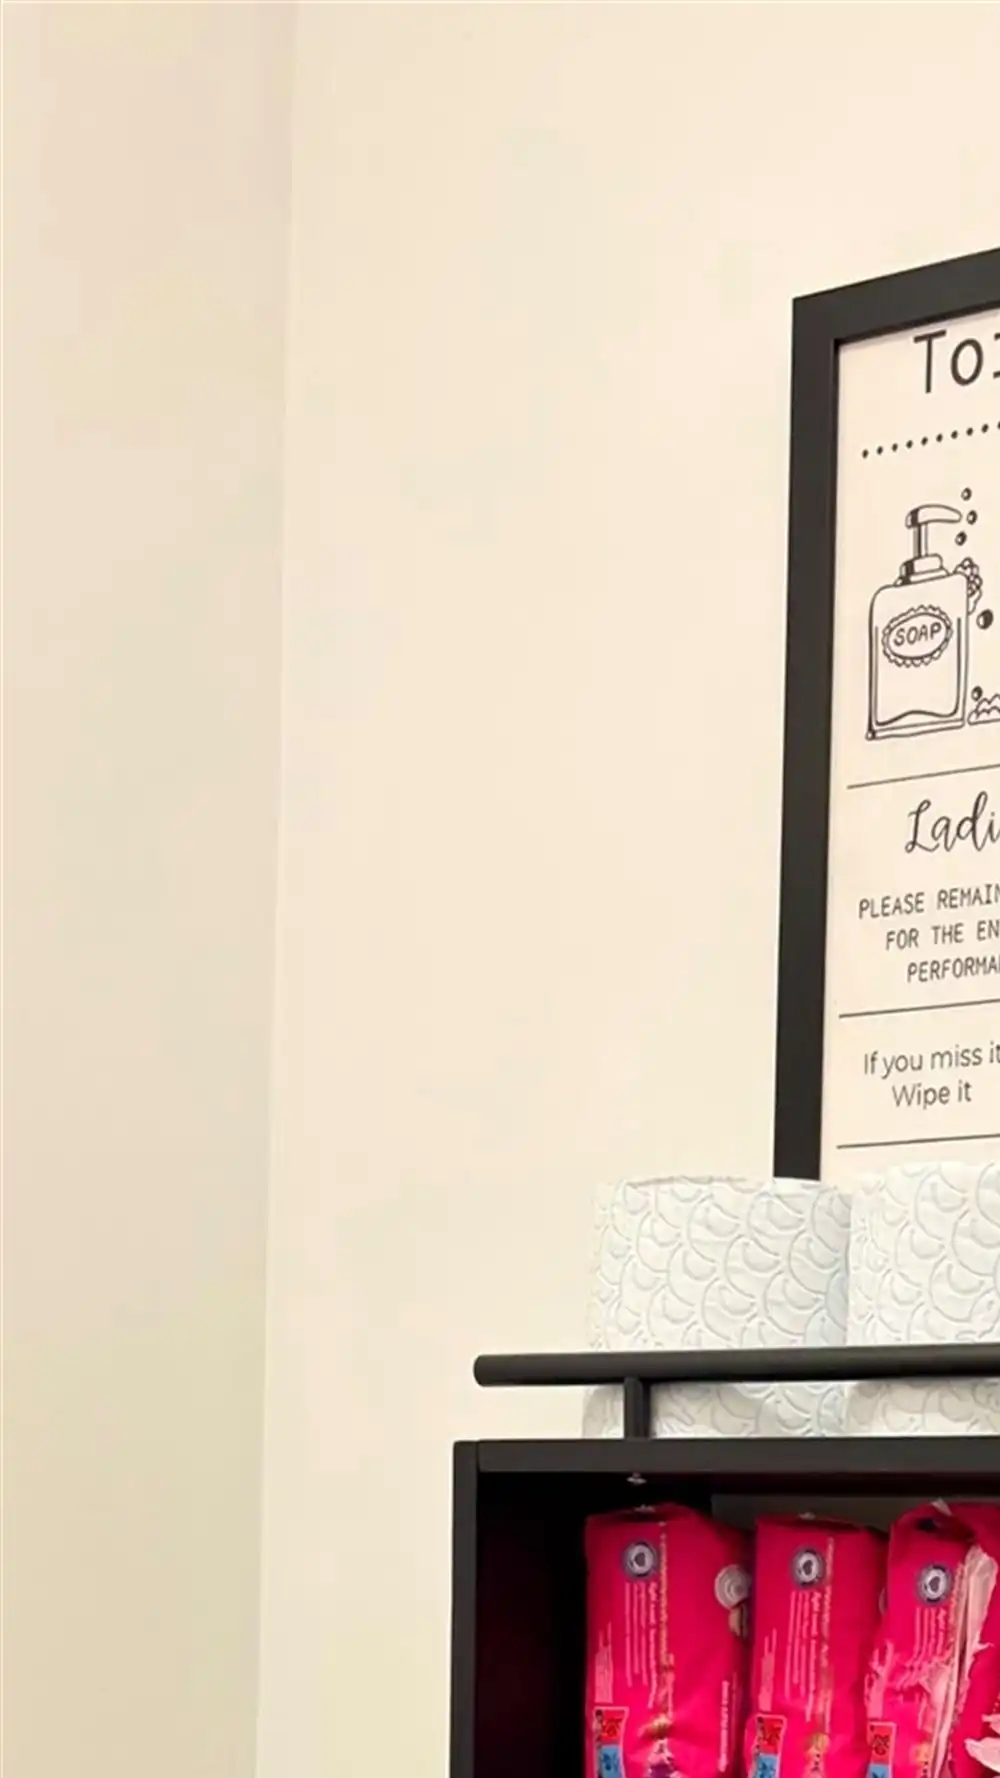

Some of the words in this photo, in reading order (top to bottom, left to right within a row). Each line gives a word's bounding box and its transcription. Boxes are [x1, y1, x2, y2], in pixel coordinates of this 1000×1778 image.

[893, 621, 942, 646] SOAP
[858, 891, 924, 919] PLEASE
[885, 927, 919, 950] FOR
[931, 922, 963, 944] THE
[864, 1051, 878, 1074] If
[881, 1054, 923, 1079] you
[931, 1045, 984, 1070] miss
[891, 1082, 950, 1109] Wipe
[957, 1079, 971, 1102] it
